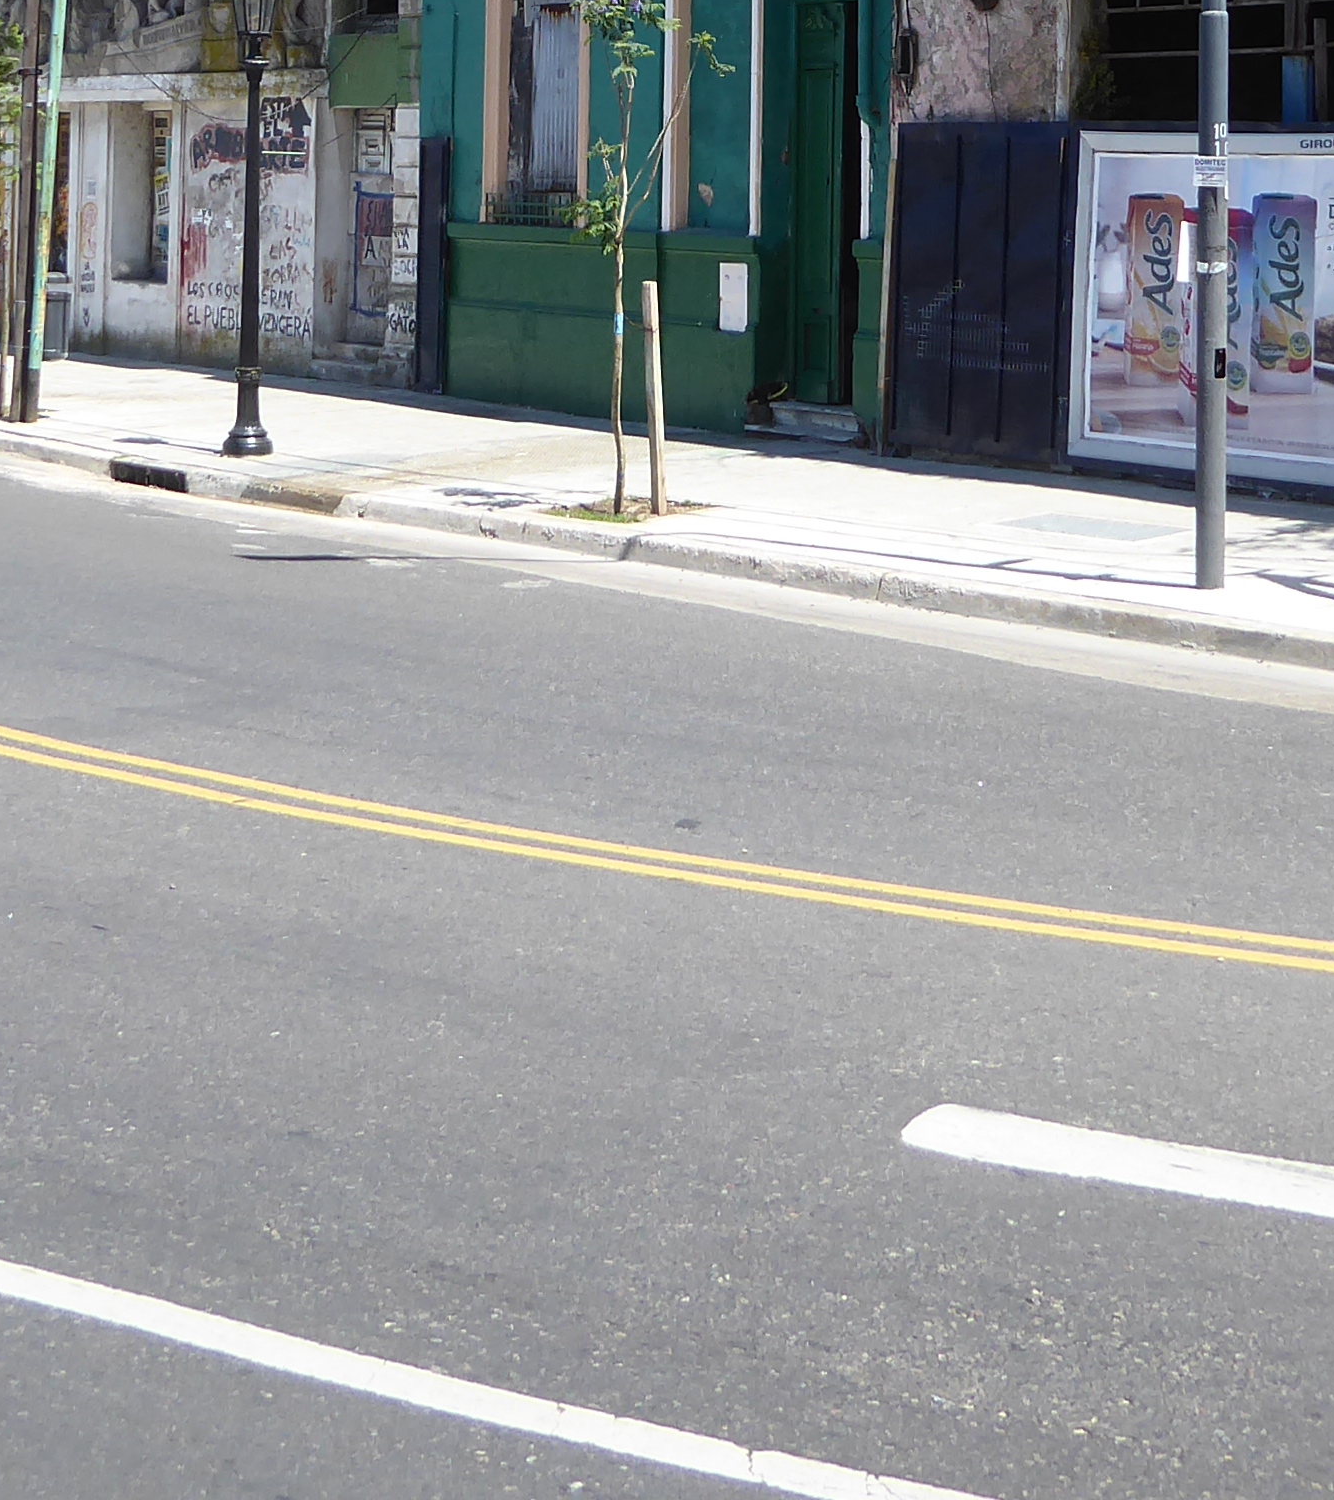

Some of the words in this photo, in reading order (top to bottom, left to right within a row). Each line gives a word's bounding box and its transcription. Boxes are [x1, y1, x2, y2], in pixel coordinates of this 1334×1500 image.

[1213, 122, 1227, 140] 10
[1142, 208, 1175, 316] AdeS
[1268, 214, 1305, 322] AdeS
[187, 305, 202, 325] EL
[204, 305, 242, 331] PUEBL
